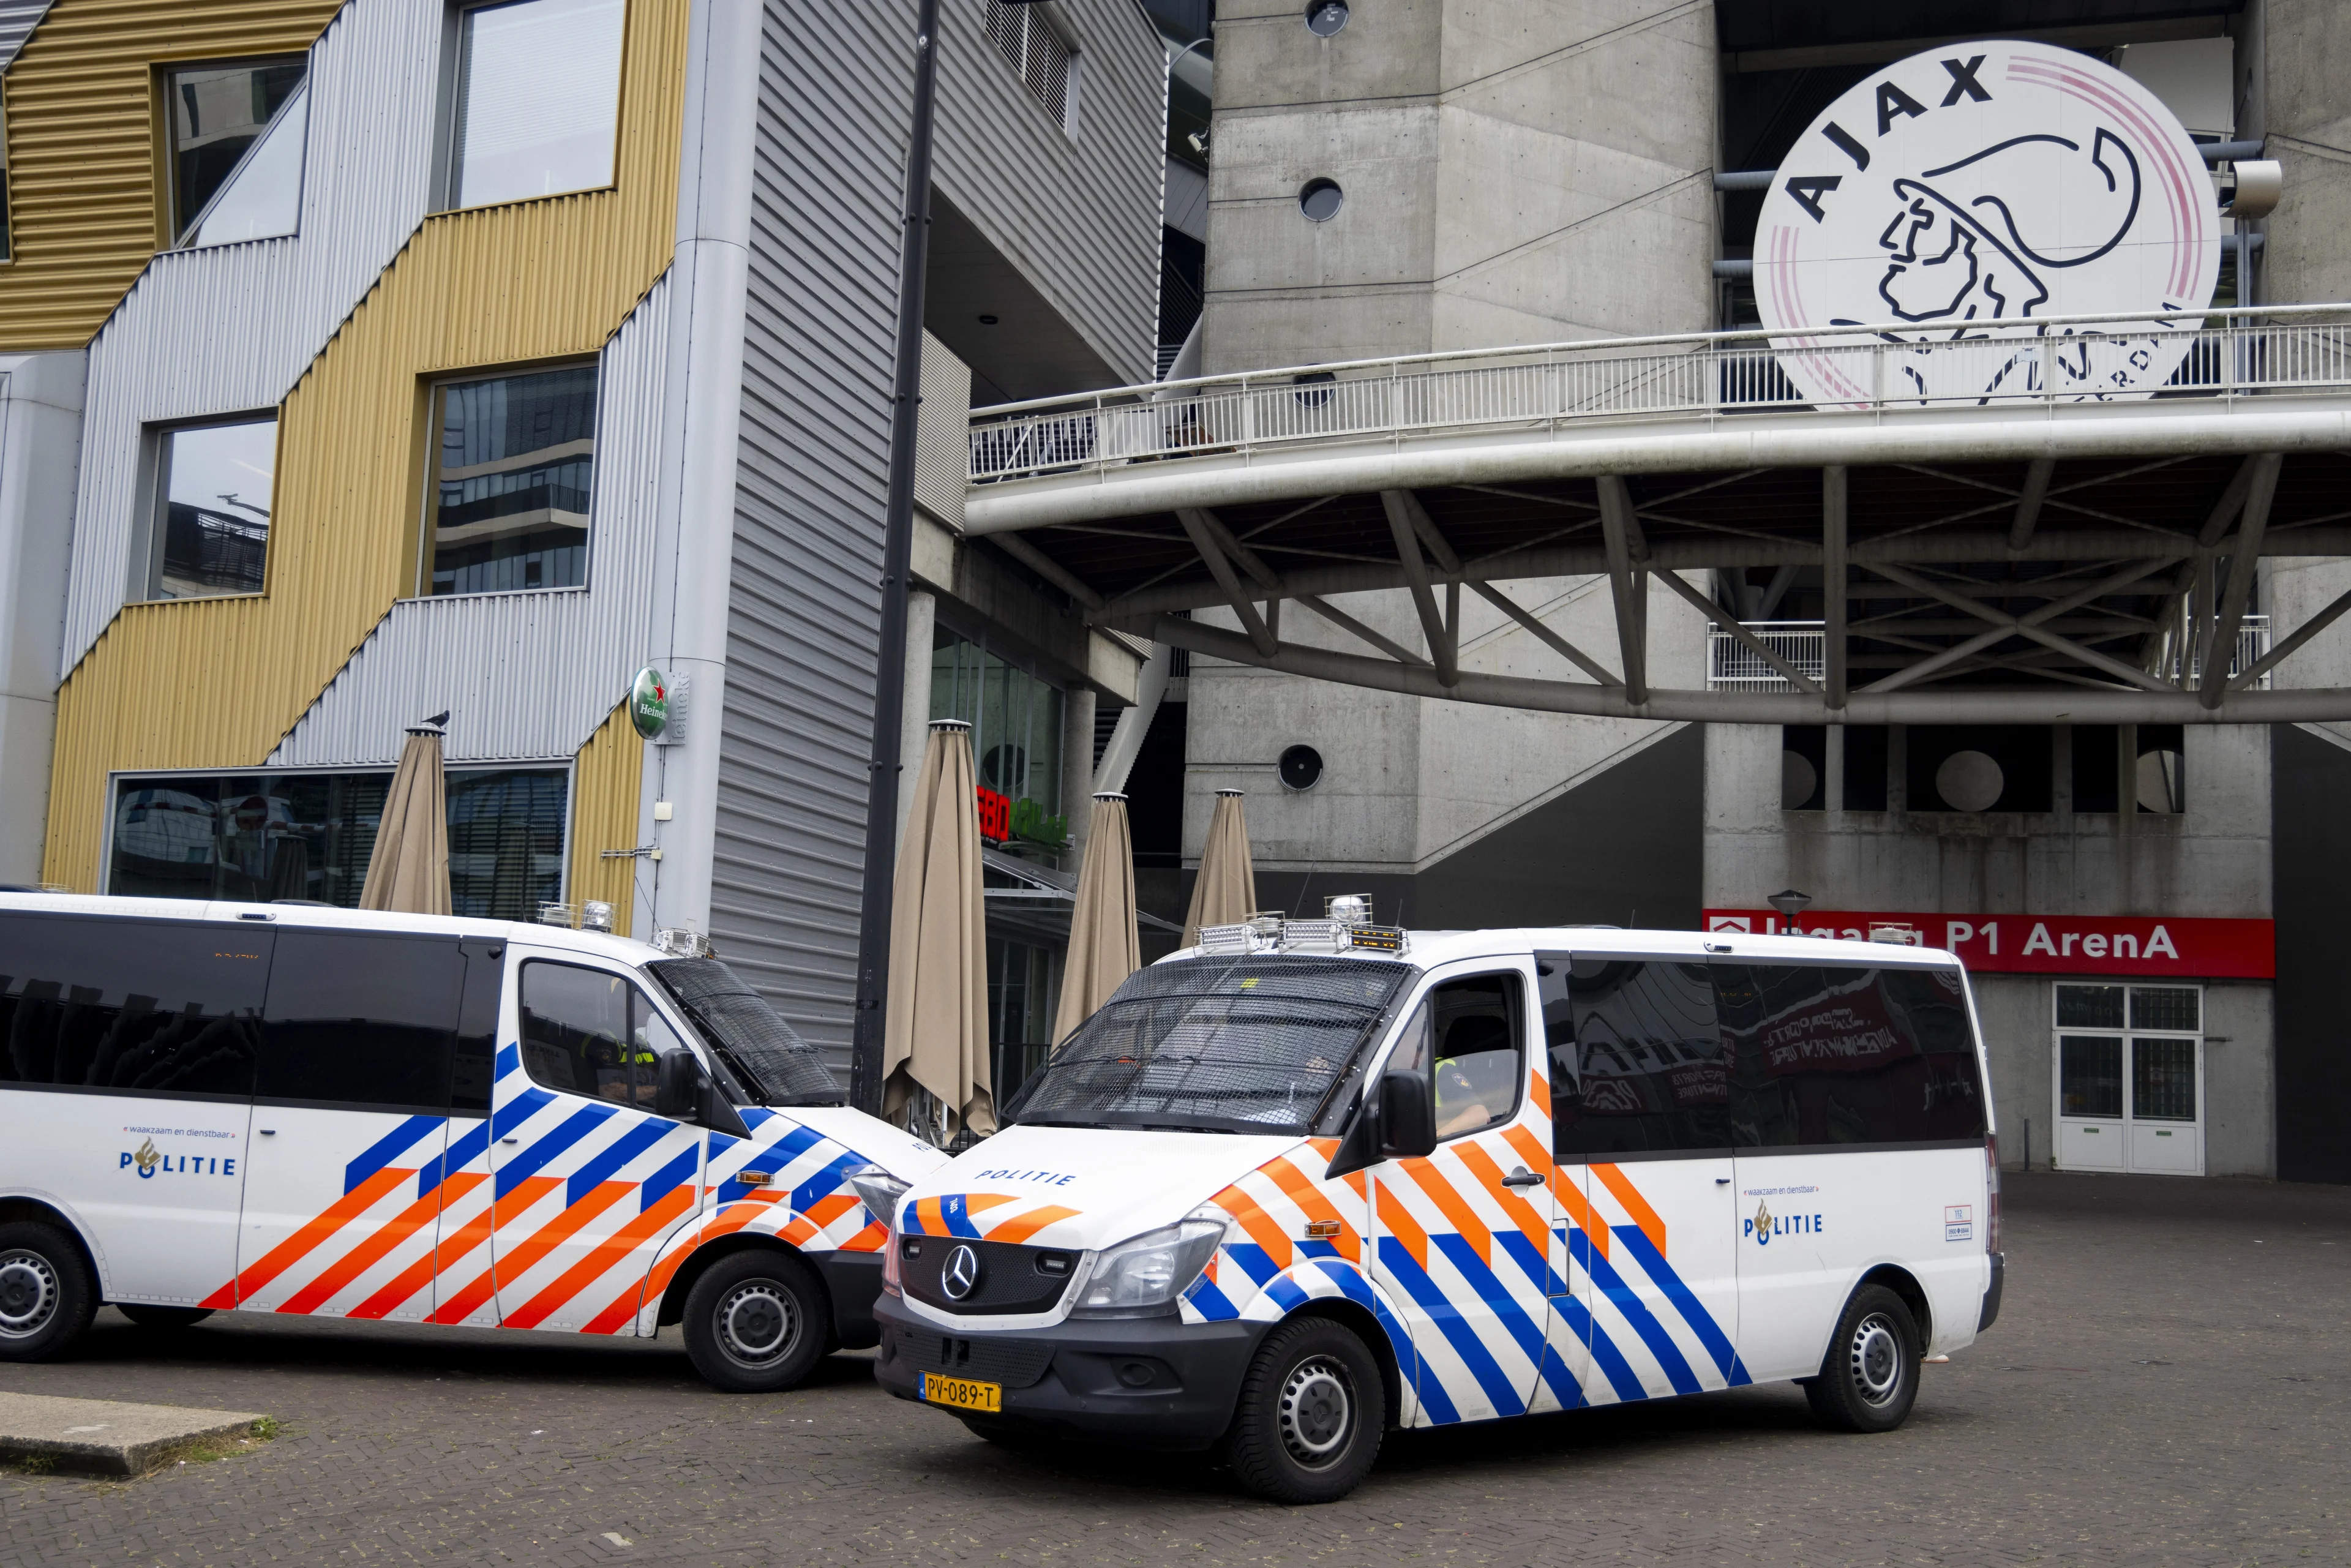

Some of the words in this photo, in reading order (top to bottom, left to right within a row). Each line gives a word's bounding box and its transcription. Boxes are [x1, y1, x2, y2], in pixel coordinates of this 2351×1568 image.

[1784, 54, 1993, 224] AJAX
[640, 703, 668, 721] Heineke
[1946, 920, 1998, 955] P1
[2022, 922, 2179, 959] ArenA
[129, 1126, 173, 1135] waakzaam
[186, 1128, 230, 1139] dienstbaar
[119, 1152, 236, 1179] POLITIE
[974, 1169, 1077, 1186] POLITIE
[1787, 1185, 1815, 1195] dienstbaar
[1744, 1214, 1823, 1246] POLITIE
[928, 1378, 994, 1407] PV-089-T
